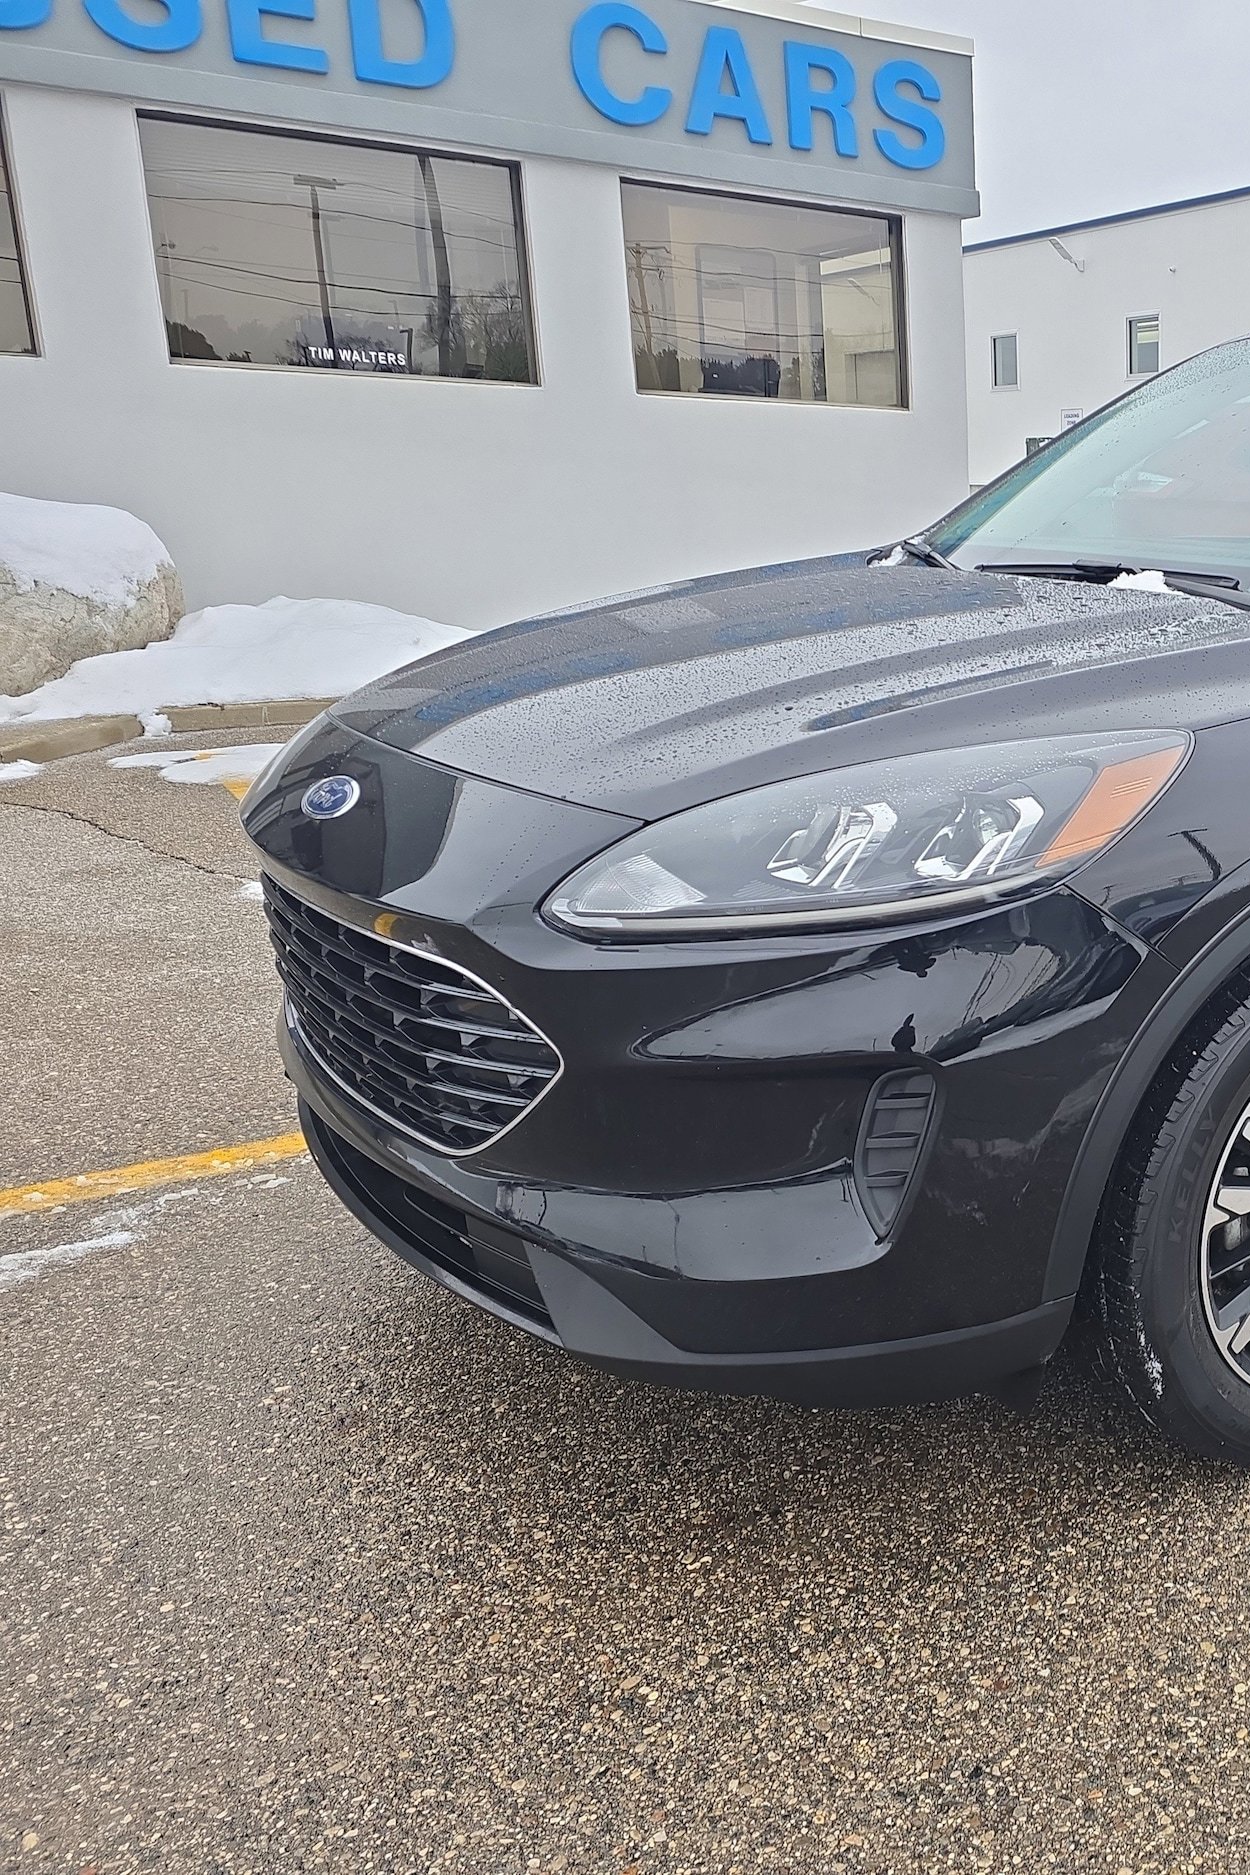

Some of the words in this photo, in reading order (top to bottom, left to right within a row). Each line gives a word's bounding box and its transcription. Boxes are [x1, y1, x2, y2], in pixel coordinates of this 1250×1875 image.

[0, 0, 456, 89] ED
[570, 2, 945, 170] CARS
[308, 346, 334, 360] TIM
[338, 348, 406, 366] WALTERS
[1168, 1104, 1217, 1243] KELLY
